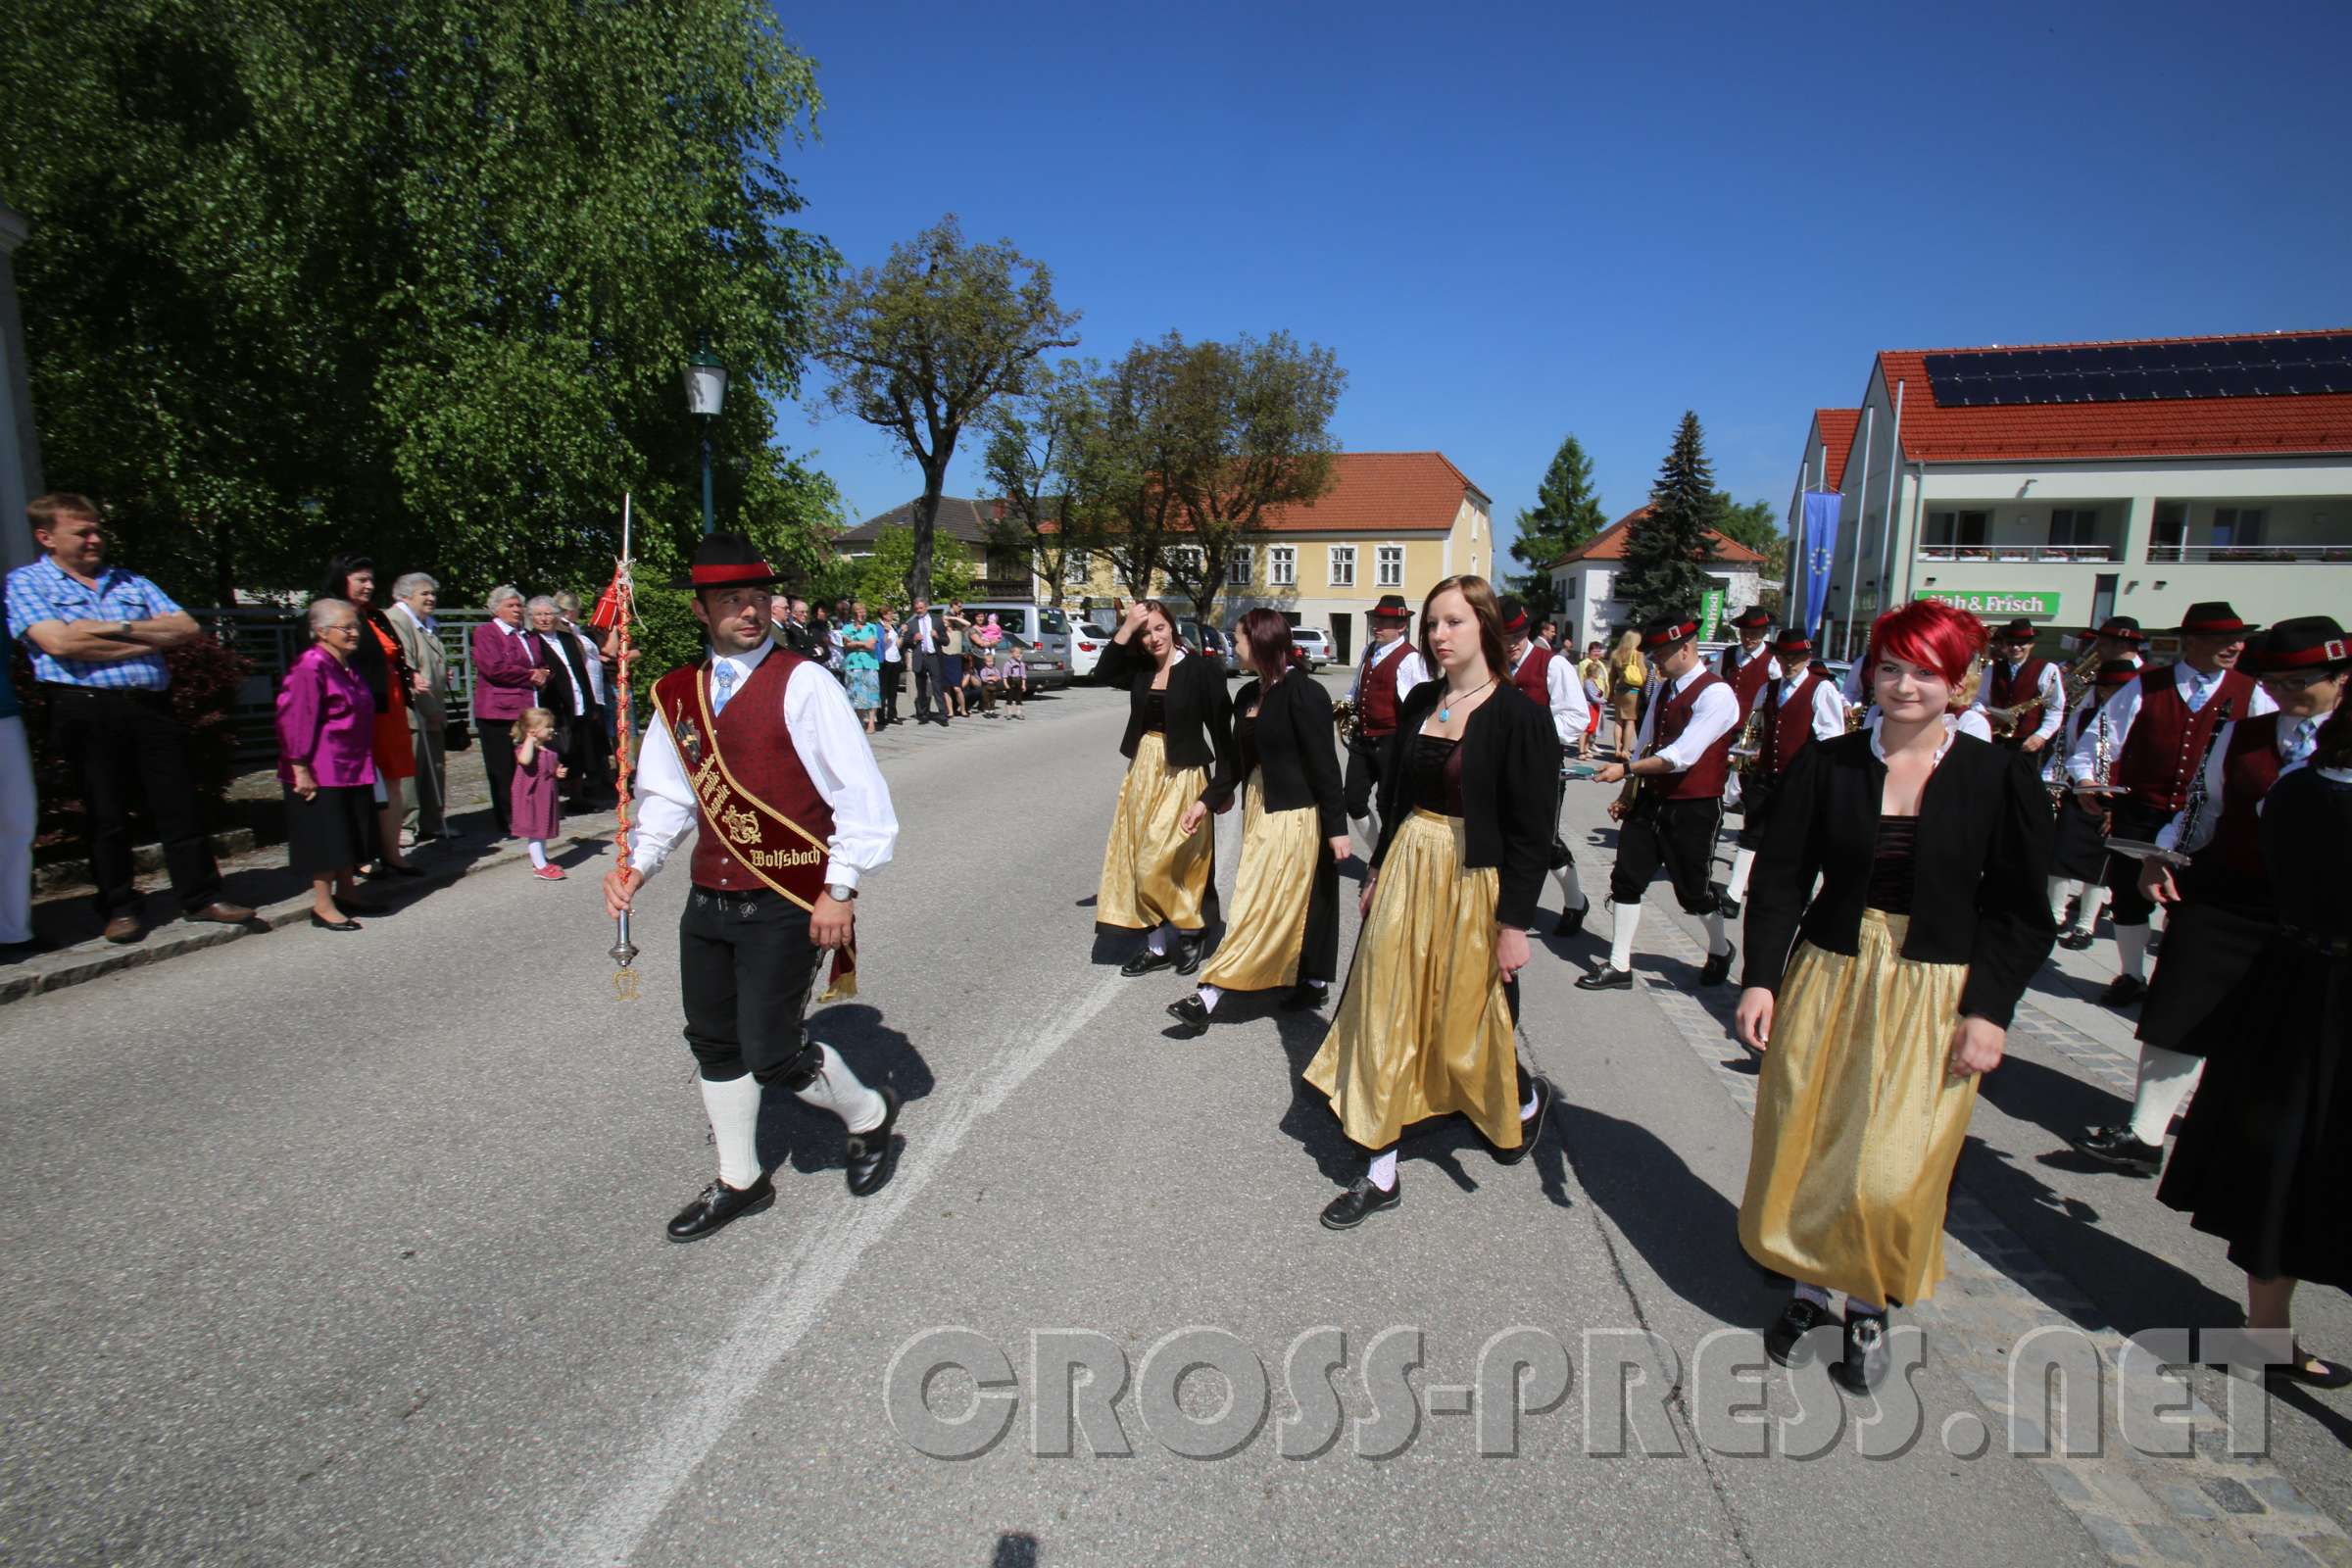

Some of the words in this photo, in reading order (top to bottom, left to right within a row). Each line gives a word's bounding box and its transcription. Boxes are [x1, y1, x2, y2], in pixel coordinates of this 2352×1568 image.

[1968, 596, 1984, 612] &
[1984, 594, 2043, 612] Frisch
[749, 846, 820, 869] Wolfsbach
